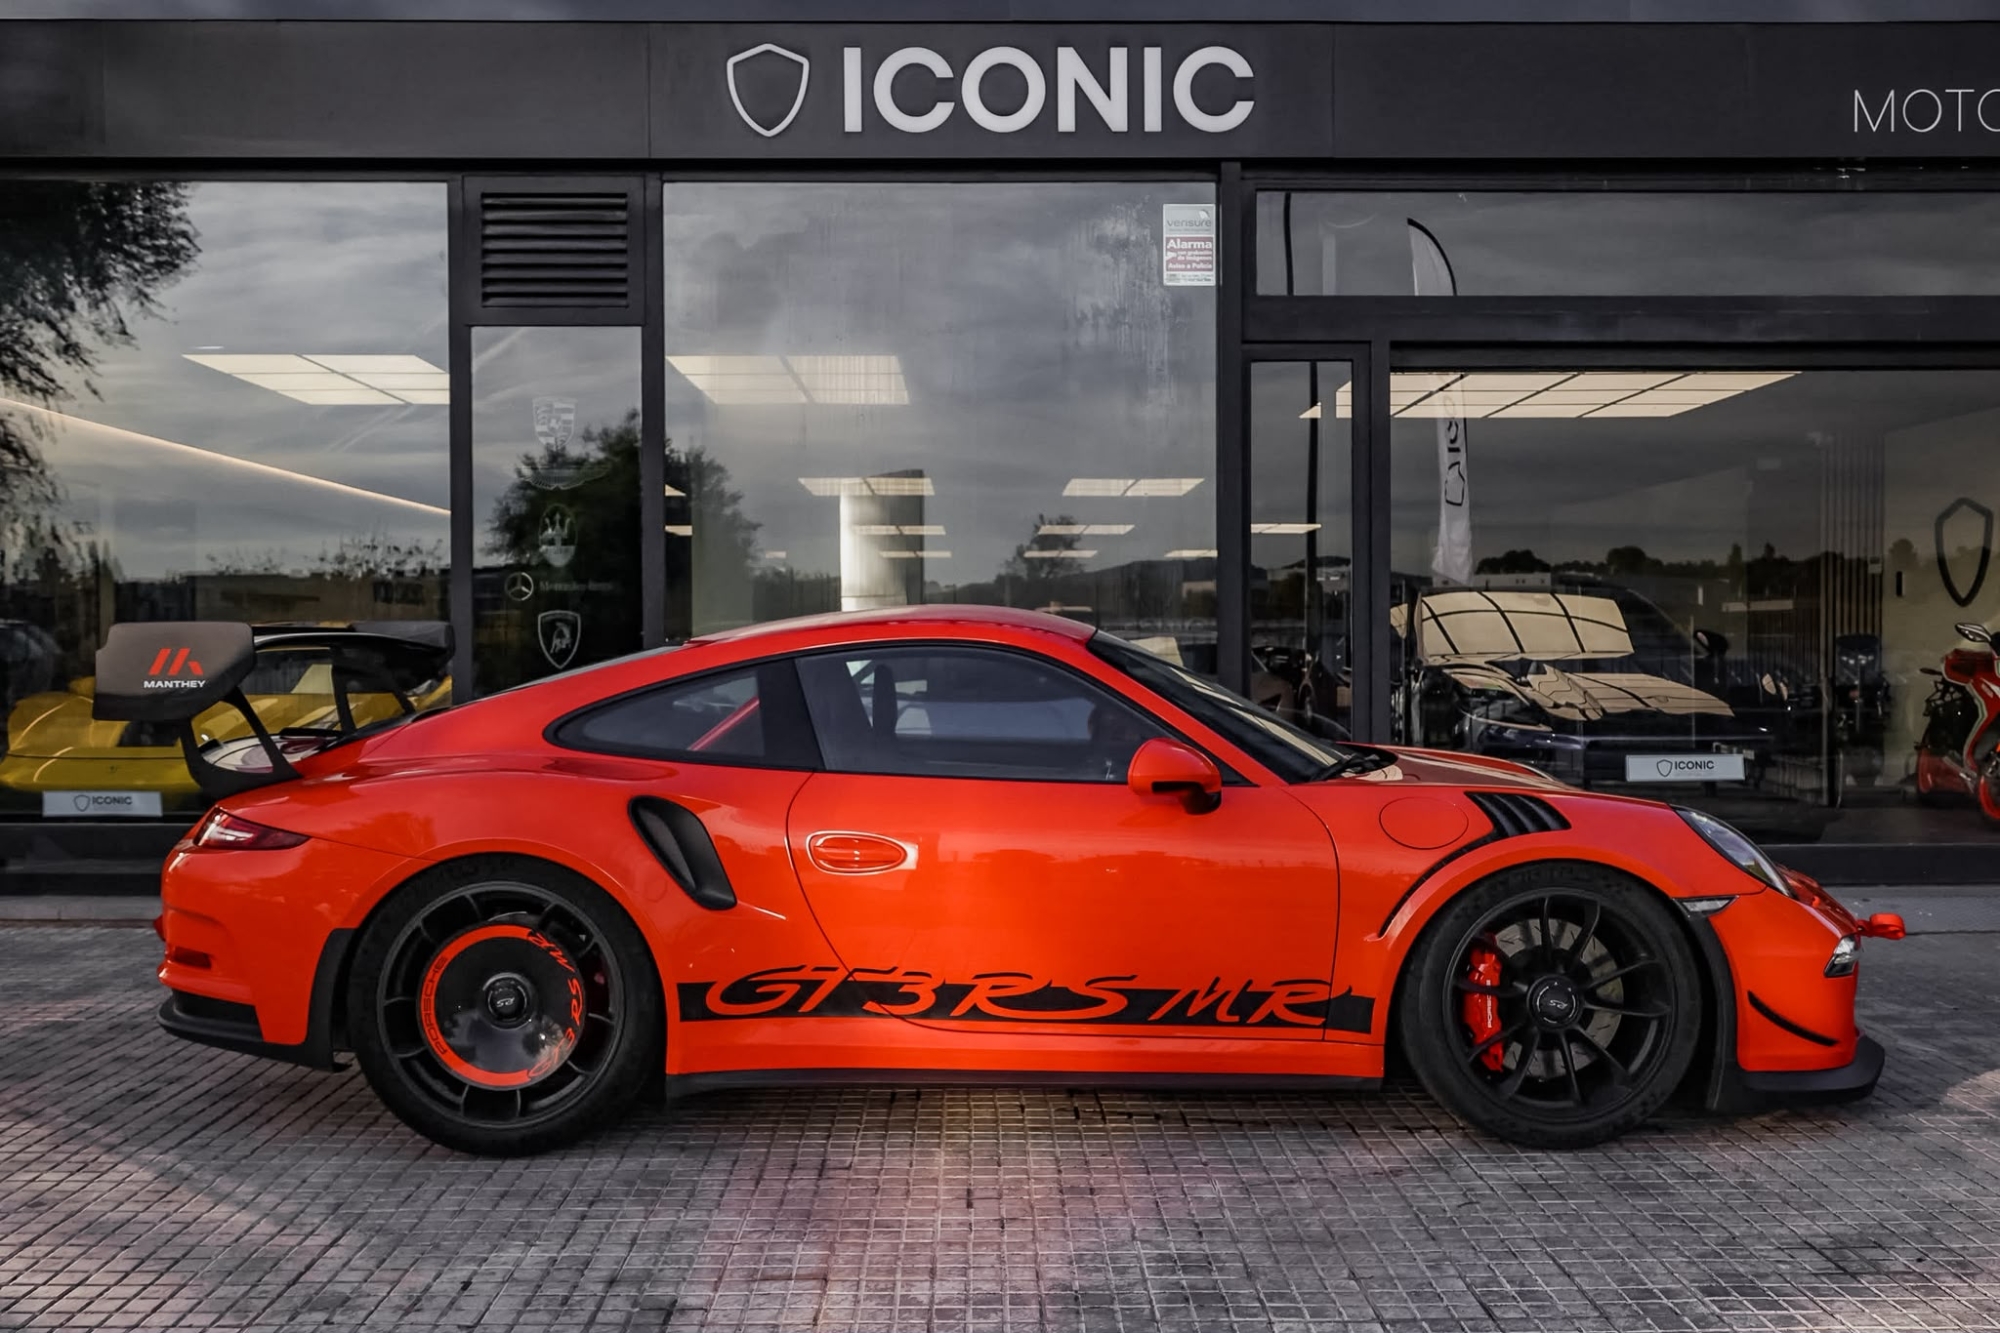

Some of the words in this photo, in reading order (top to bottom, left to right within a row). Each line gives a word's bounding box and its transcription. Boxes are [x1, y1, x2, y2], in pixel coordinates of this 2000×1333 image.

[844, 46, 1255, 133] ICONIC
[1167, 219, 1212, 227] verisure
[1167, 238, 1212, 249] Alarma
[143, 680, 206, 688] MANTHEY
[1674, 760, 1715, 770] ICONIC
[92, 796, 132, 805] ICONIC
[423, 956, 448, 1055] PORSCHE
[1148, 976, 1340, 1026] MR
